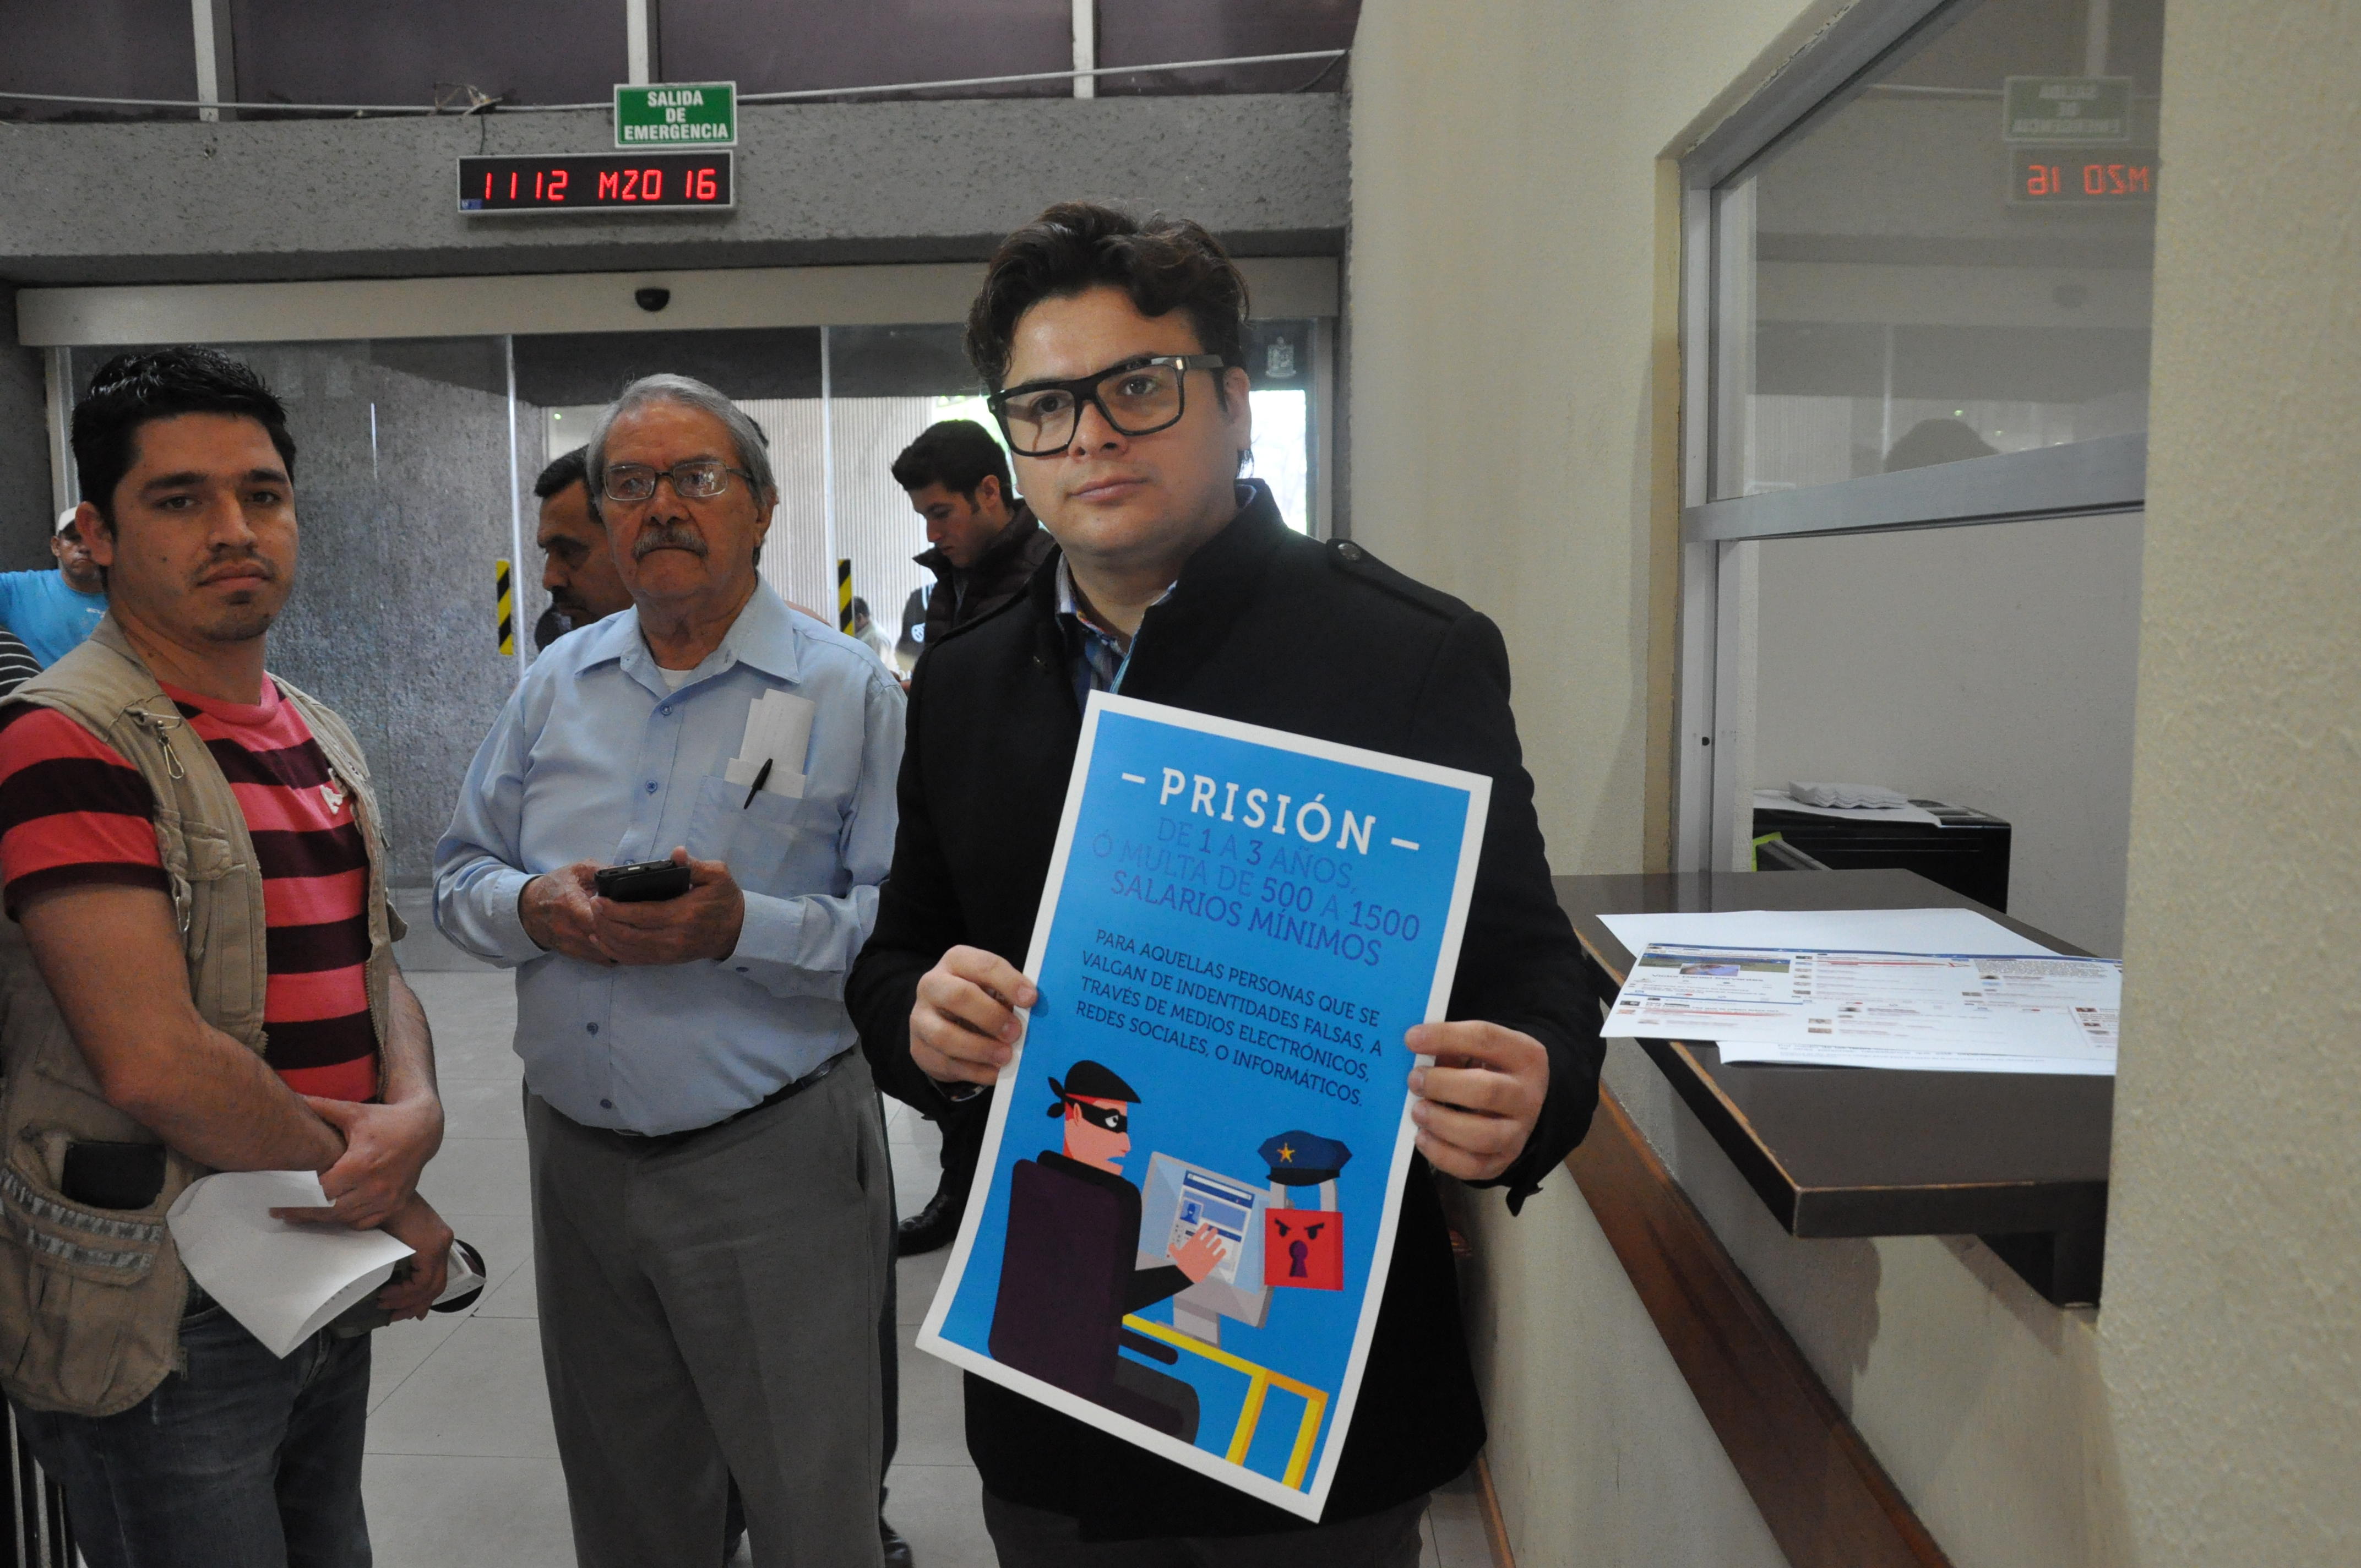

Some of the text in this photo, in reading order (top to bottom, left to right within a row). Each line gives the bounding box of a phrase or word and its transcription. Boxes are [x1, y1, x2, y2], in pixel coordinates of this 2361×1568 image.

[624, 123, 728, 140] EMERGENCIA
[647, 90, 704, 107] SALIDA
[665, 108, 686, 123] DE
[685, 168, 716, 199] 16
[1158, 816, 1358, 894] DE 1 A 3 AÑOS,
[1160, 767, 1376, 855] PRISIÓN
[1112, 869, 1382, 966] SALARIOS MÍNIMOS
[1118, 840, 1207, 885] MULTA
[1217, 865, 1254, 897] DE
[1261, 877, 1313, 912] 500
[1320, 894, 1339, 921] A
[1349, 900, 1419, 941] 1500
[1082, 950, 1382, 1057] VALGAN DE INDENTIDADES FALSAS, A
[1096, 929, 1379, 1027] PARA AQUELLAS PERSONAS QUE SE
[1076, 1000, 1363, 1107] REDES SOCIALES, O INFORMÁTICOS.
[1081, 976, 1370, 1082] TRAVÉS DE MEDIOS ELECTRÓNICOS,
